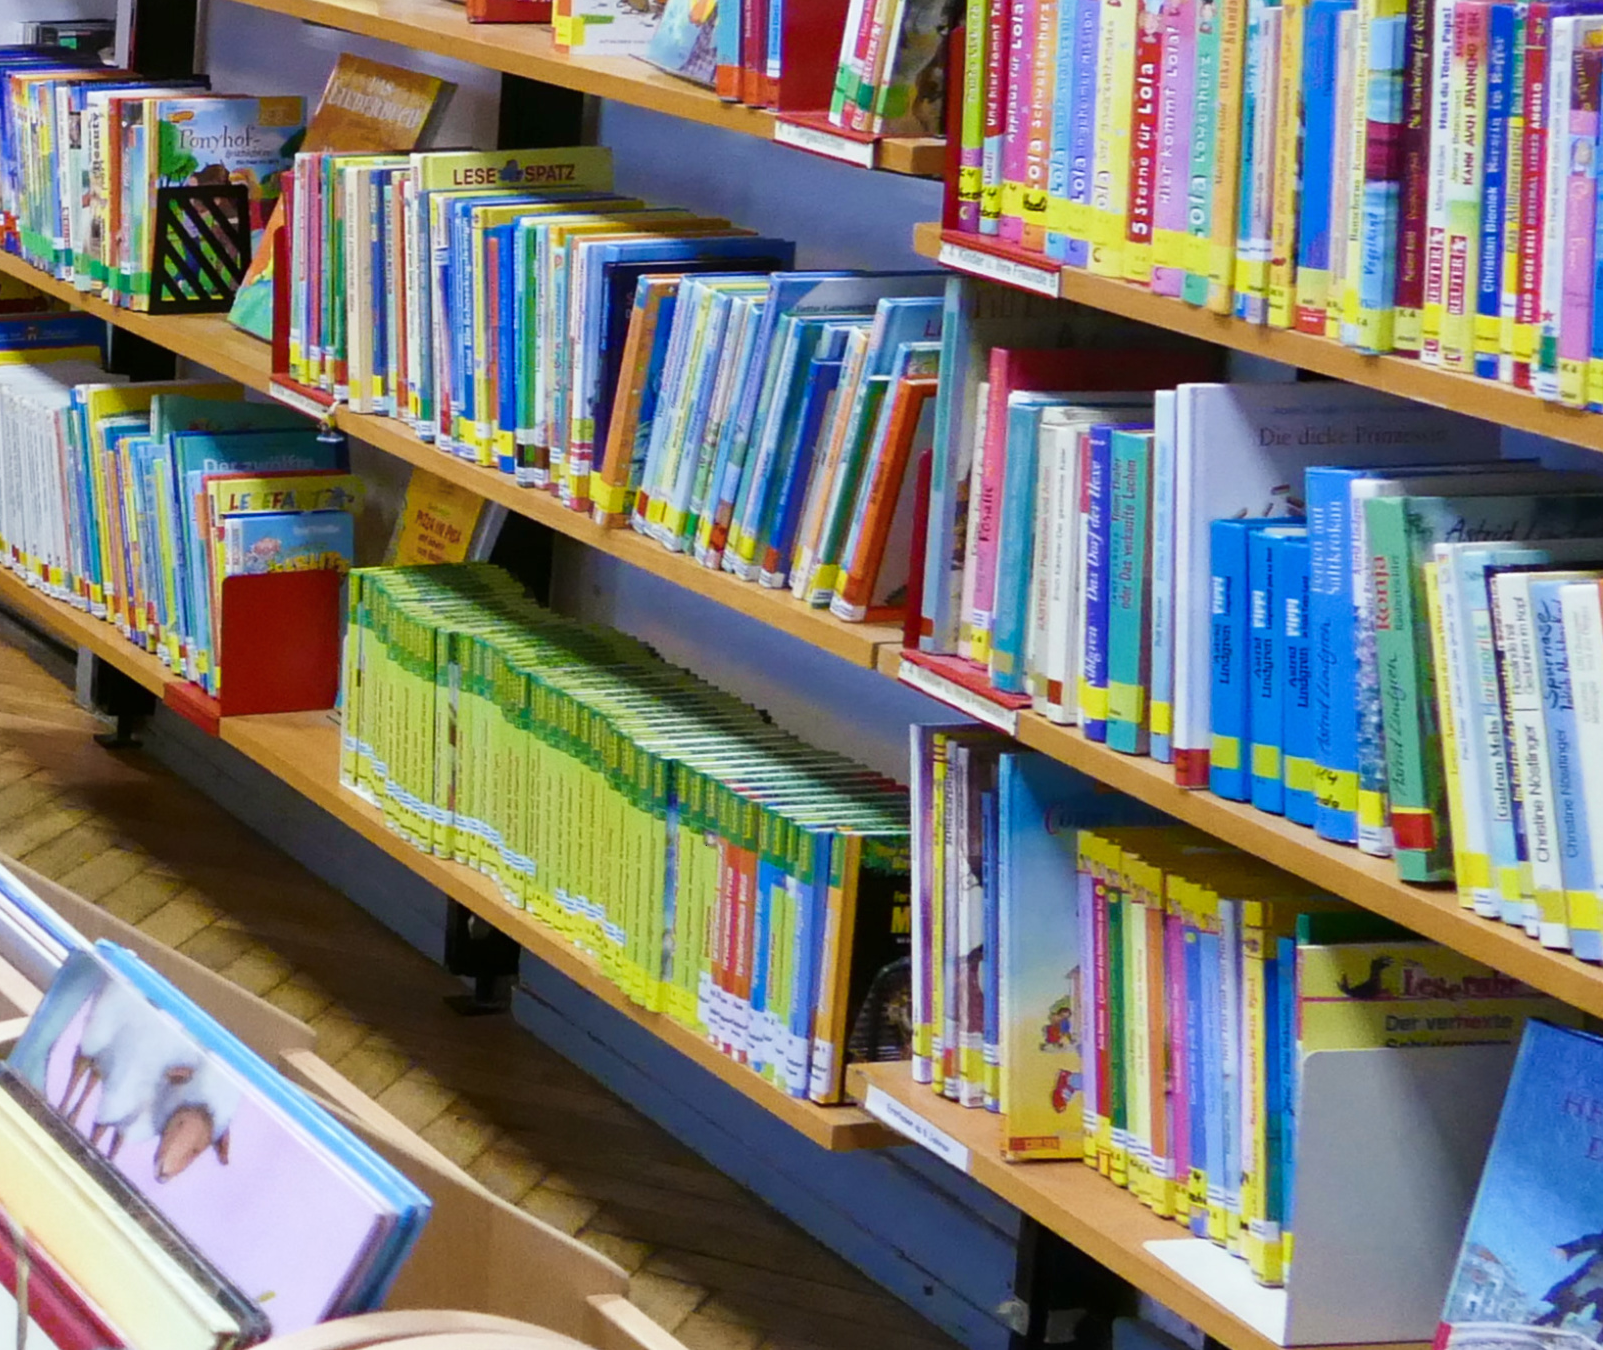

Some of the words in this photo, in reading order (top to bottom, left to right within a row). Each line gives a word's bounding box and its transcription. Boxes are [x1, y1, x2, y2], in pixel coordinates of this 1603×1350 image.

[989, 22, 1002, 68] kommt
[1440, 7, 1454, 43] Papa!
[1007, 55, 1021, 78] für
[1164, 27, 1180, 78] Lola!
[986, 72, 999, 98] hier
[1136, 62, 1155, 114] Lola
[1439, 82, 1450, 99] du
[986, 102, 998, 126] Und
[1006, 83, 1020, 143] Applaus
[1069, 155, 1088, 205] Lola
[1080, 10, 1094, 64] Mission
[1160, 88, 1176, 158] kommt
[1438, 102, 1450, 130] Hast
[178, 125, 261, 151] Ponyhof-
[1136, 122, 1152, 150] für
[453, 168, 496, 186] LESE
[523, 162, 576, 182] SPATZ
[1049, 148, 1065, 196] Lola
[1134, 156, 1150, 216] Sterne
[1159, 167, 1174, 205] Hier
[1130, 221, 1147, 236] 5
[1448, 257, 1464, 315] REUTER
[1259, 427, 1290, 448] Die
[1297, 427, 1346, 447] dicke
[1124, 459, 1137, 499] Lachen
[1121, 560, 1132, 581] Das
[1213, 576, 1228, 615] PIPPI
[1251, 590, 1267, 629] PIPPI
[1374, 556, 1392, 632] Ronja
[1286, 597, 1301, 637] PIPPI
[1219, 625, 1232, 685] Lindgren
[1261, 638, 1274, 699] Lindgren
[1297, 646, 1312, 709] Lindgren
[1523, 725, 1542, 796] Nöstlinger
[1534, 800, 1550, 863] Christine
